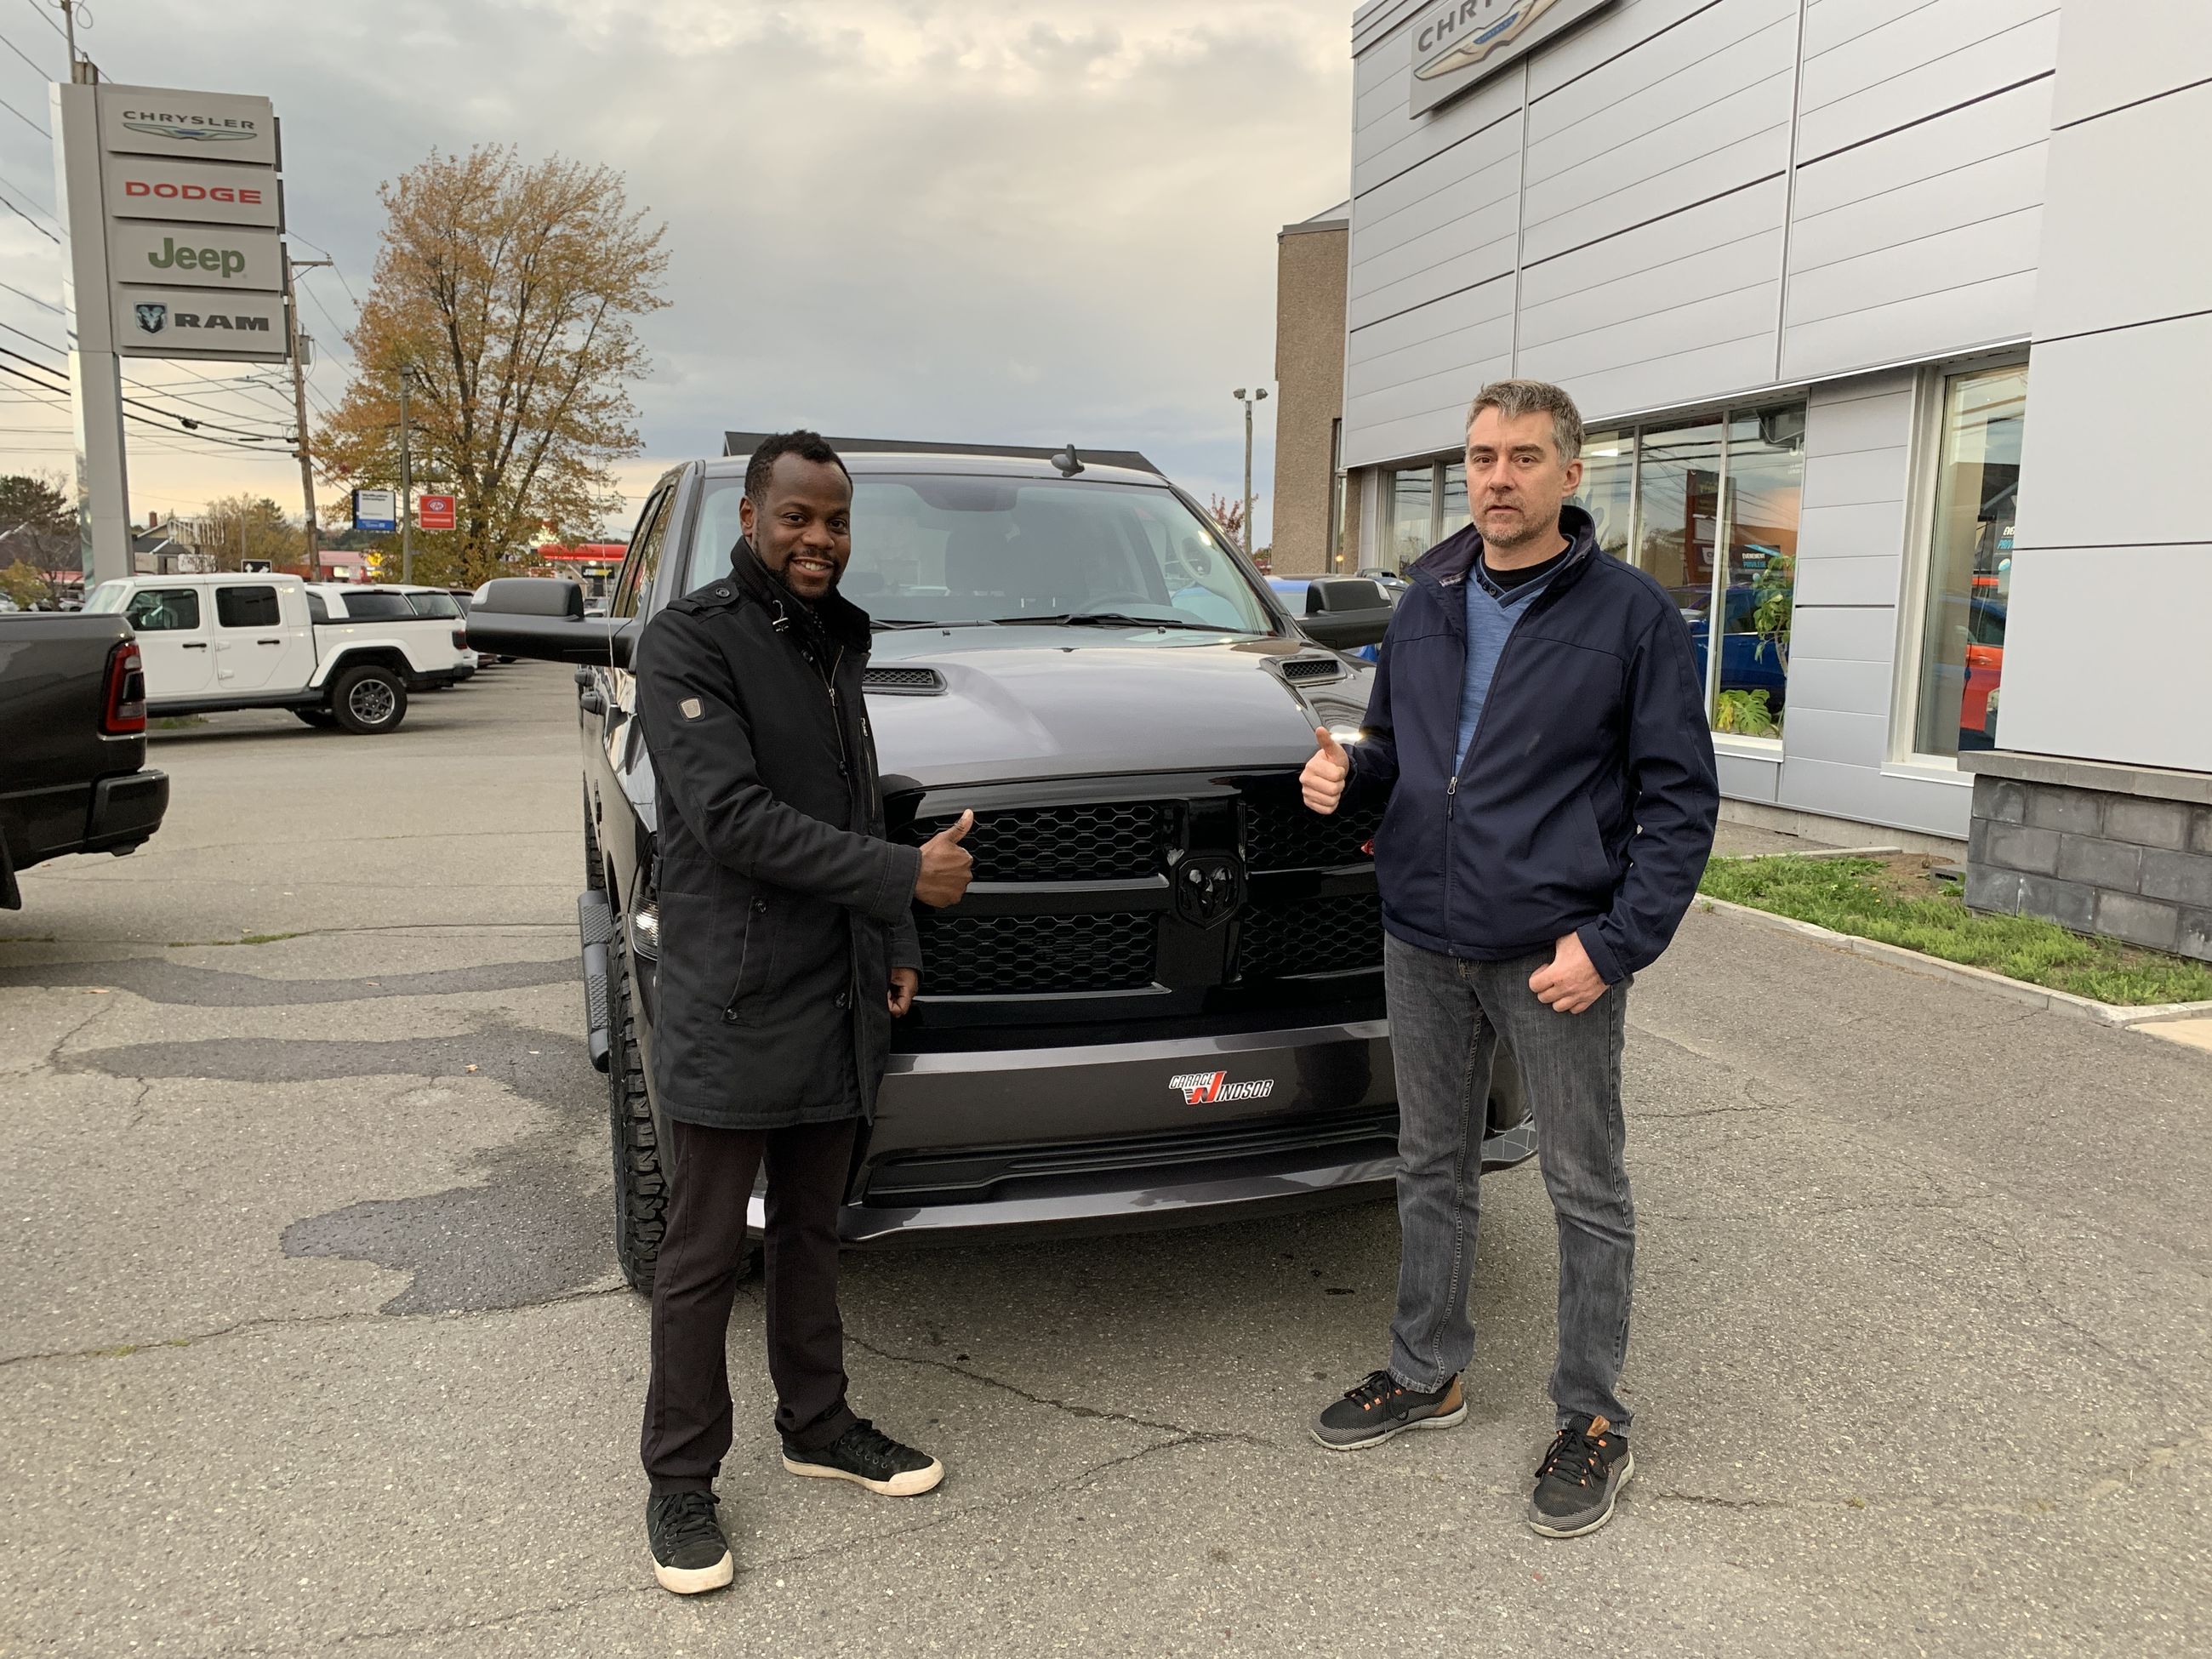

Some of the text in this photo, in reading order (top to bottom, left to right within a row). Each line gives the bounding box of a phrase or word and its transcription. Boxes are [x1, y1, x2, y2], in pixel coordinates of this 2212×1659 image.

[1418, 0, 1492, 53] CHR
[123, 111, 255, 130] CHRYSLER
[125, 181, 262, 204] DODGE
[148, 237, 245, 278] Jeep
[174, 312, 270, 332] RAM
[1169, 1073, 1214, 1089] GARAGE
